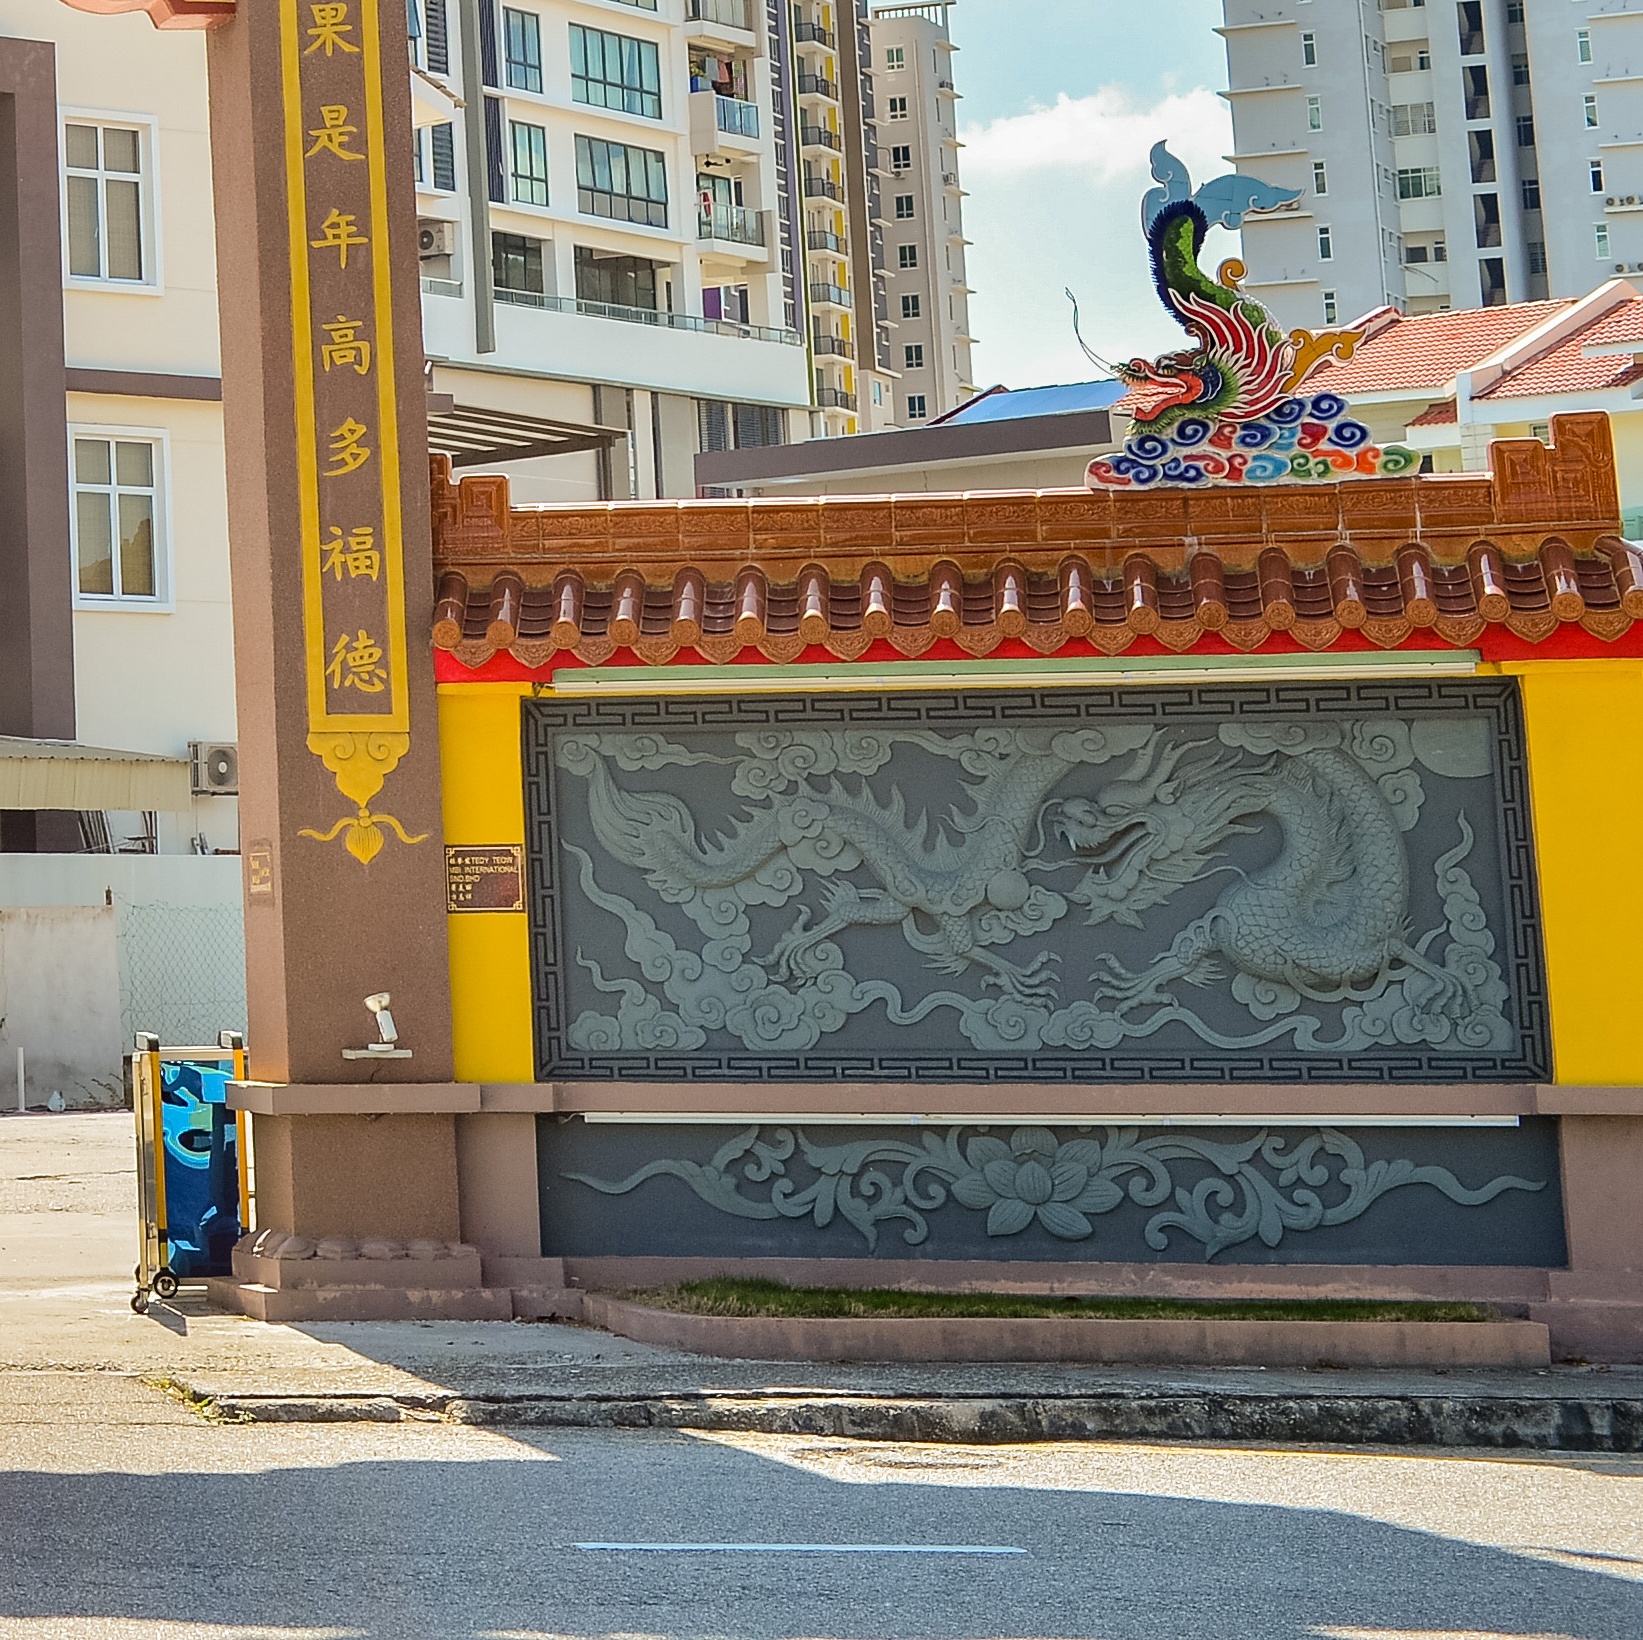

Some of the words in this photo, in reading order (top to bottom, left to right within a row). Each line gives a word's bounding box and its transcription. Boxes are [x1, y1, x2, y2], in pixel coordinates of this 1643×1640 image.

[303, 2, 388, 693] 果是年高多福德
